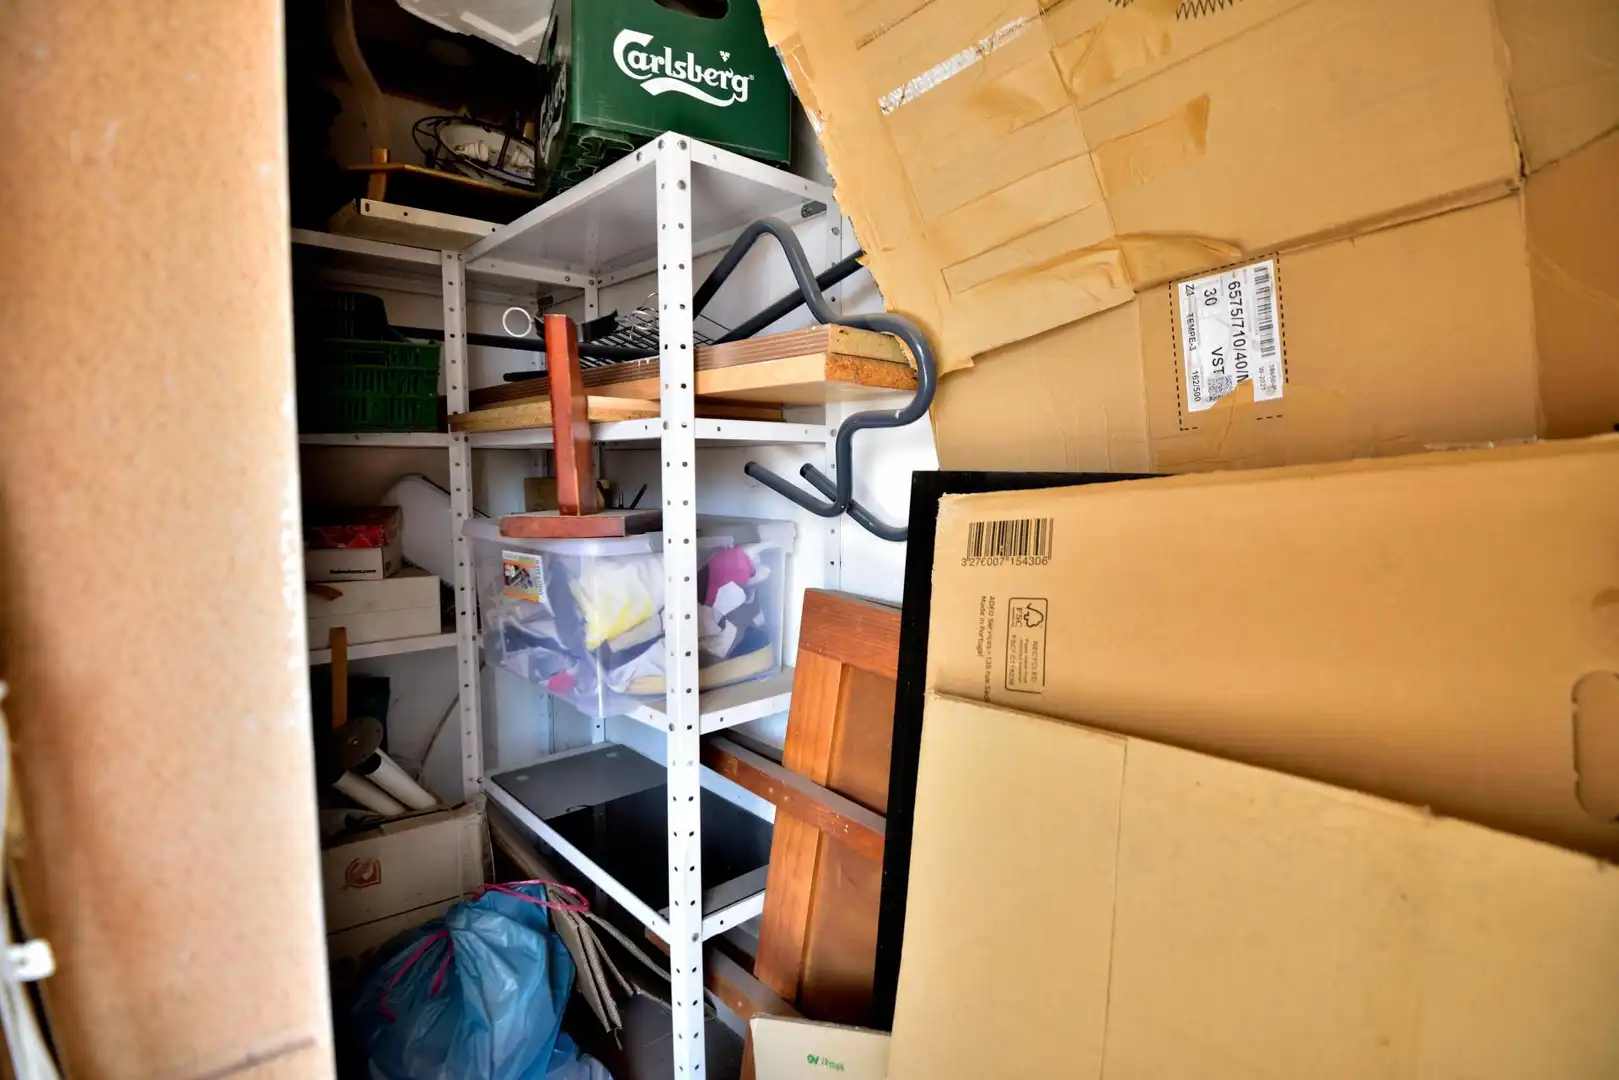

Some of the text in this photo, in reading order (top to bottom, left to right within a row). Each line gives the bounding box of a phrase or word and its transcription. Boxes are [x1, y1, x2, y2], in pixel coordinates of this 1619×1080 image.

[613, 28, 750, 105] Carlsberg
[1203, 287, 1218, 307] 30
[1186, 312, 1197, 351] TEMPE-3
[1211, 346, 1225, 375] VST
[1011, 555, 1049, 566] 154306
[979, 595, 987, 616] Made
